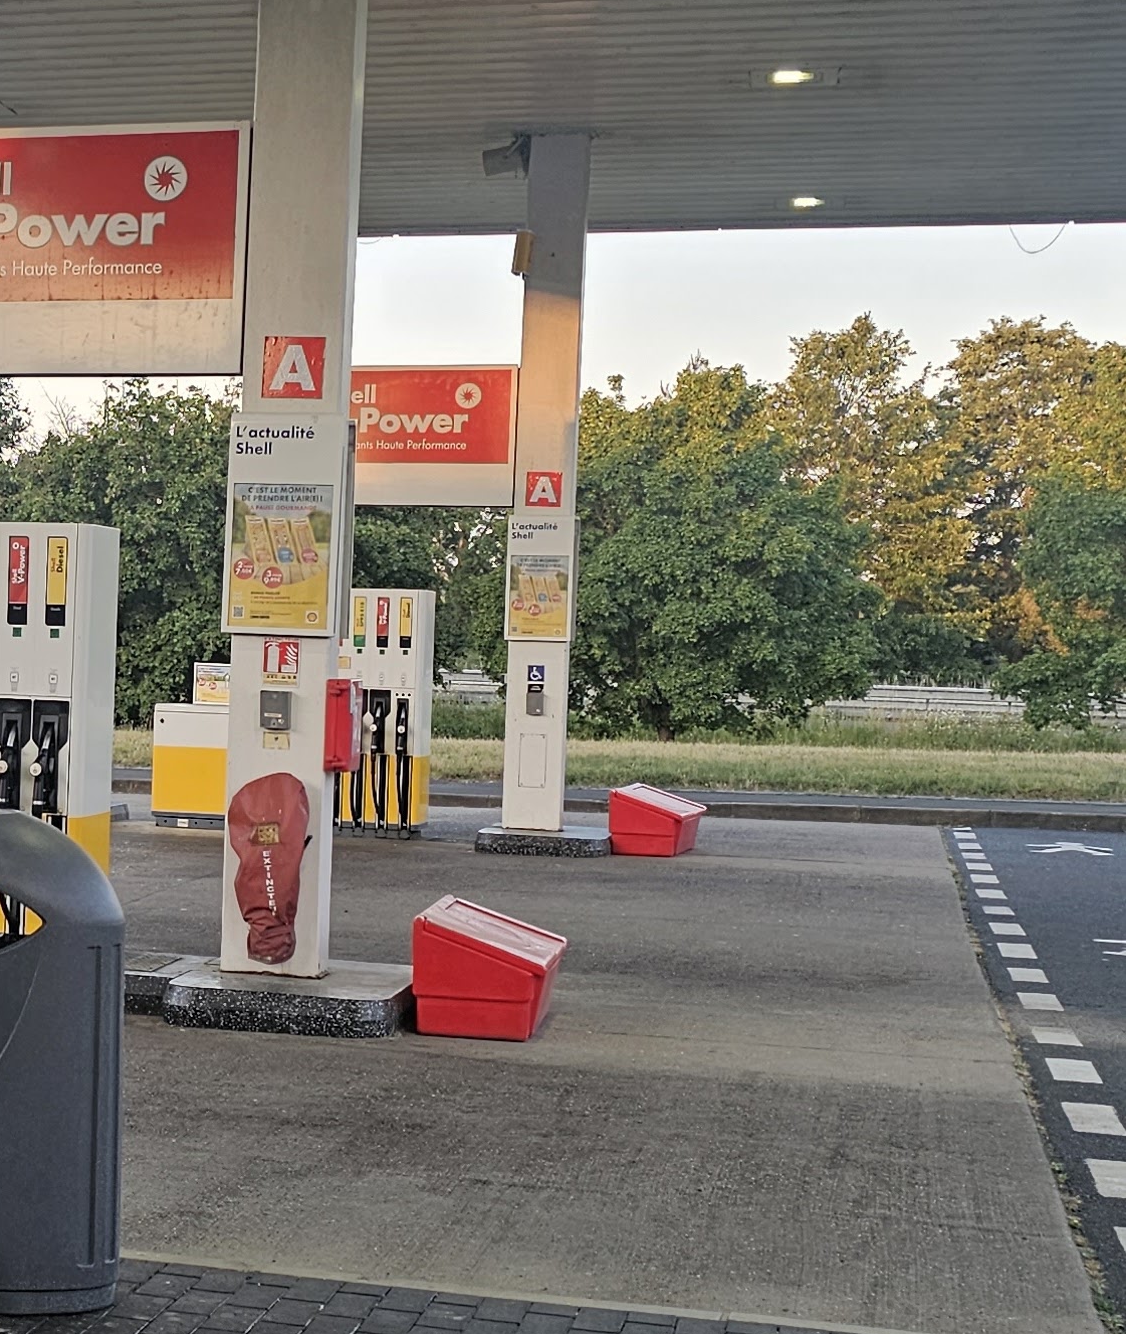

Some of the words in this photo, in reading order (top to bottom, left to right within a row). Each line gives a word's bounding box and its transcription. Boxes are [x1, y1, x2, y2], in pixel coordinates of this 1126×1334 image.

[12, 260, 57, 276] Haute
[63, 257, 162, 276] Performance
[269, 345, 316, 391] A
[351, 384, 376, 404] ell
[359, 407, 469, 434] Power
[236, 426, 315, 439] L'actualité
[236, 442, 272, 455] Shell
[376, 440, 404, 450] Haute
[407, 438, 467, 450] Performance
[529, 477, 557, 503] A
[511, 522, 558, 531] L'actualité
[511, 531, 534, 539] Shell
[17, 545, 26, 584] V-Power
[56, 546, 64, 573] Diesel
